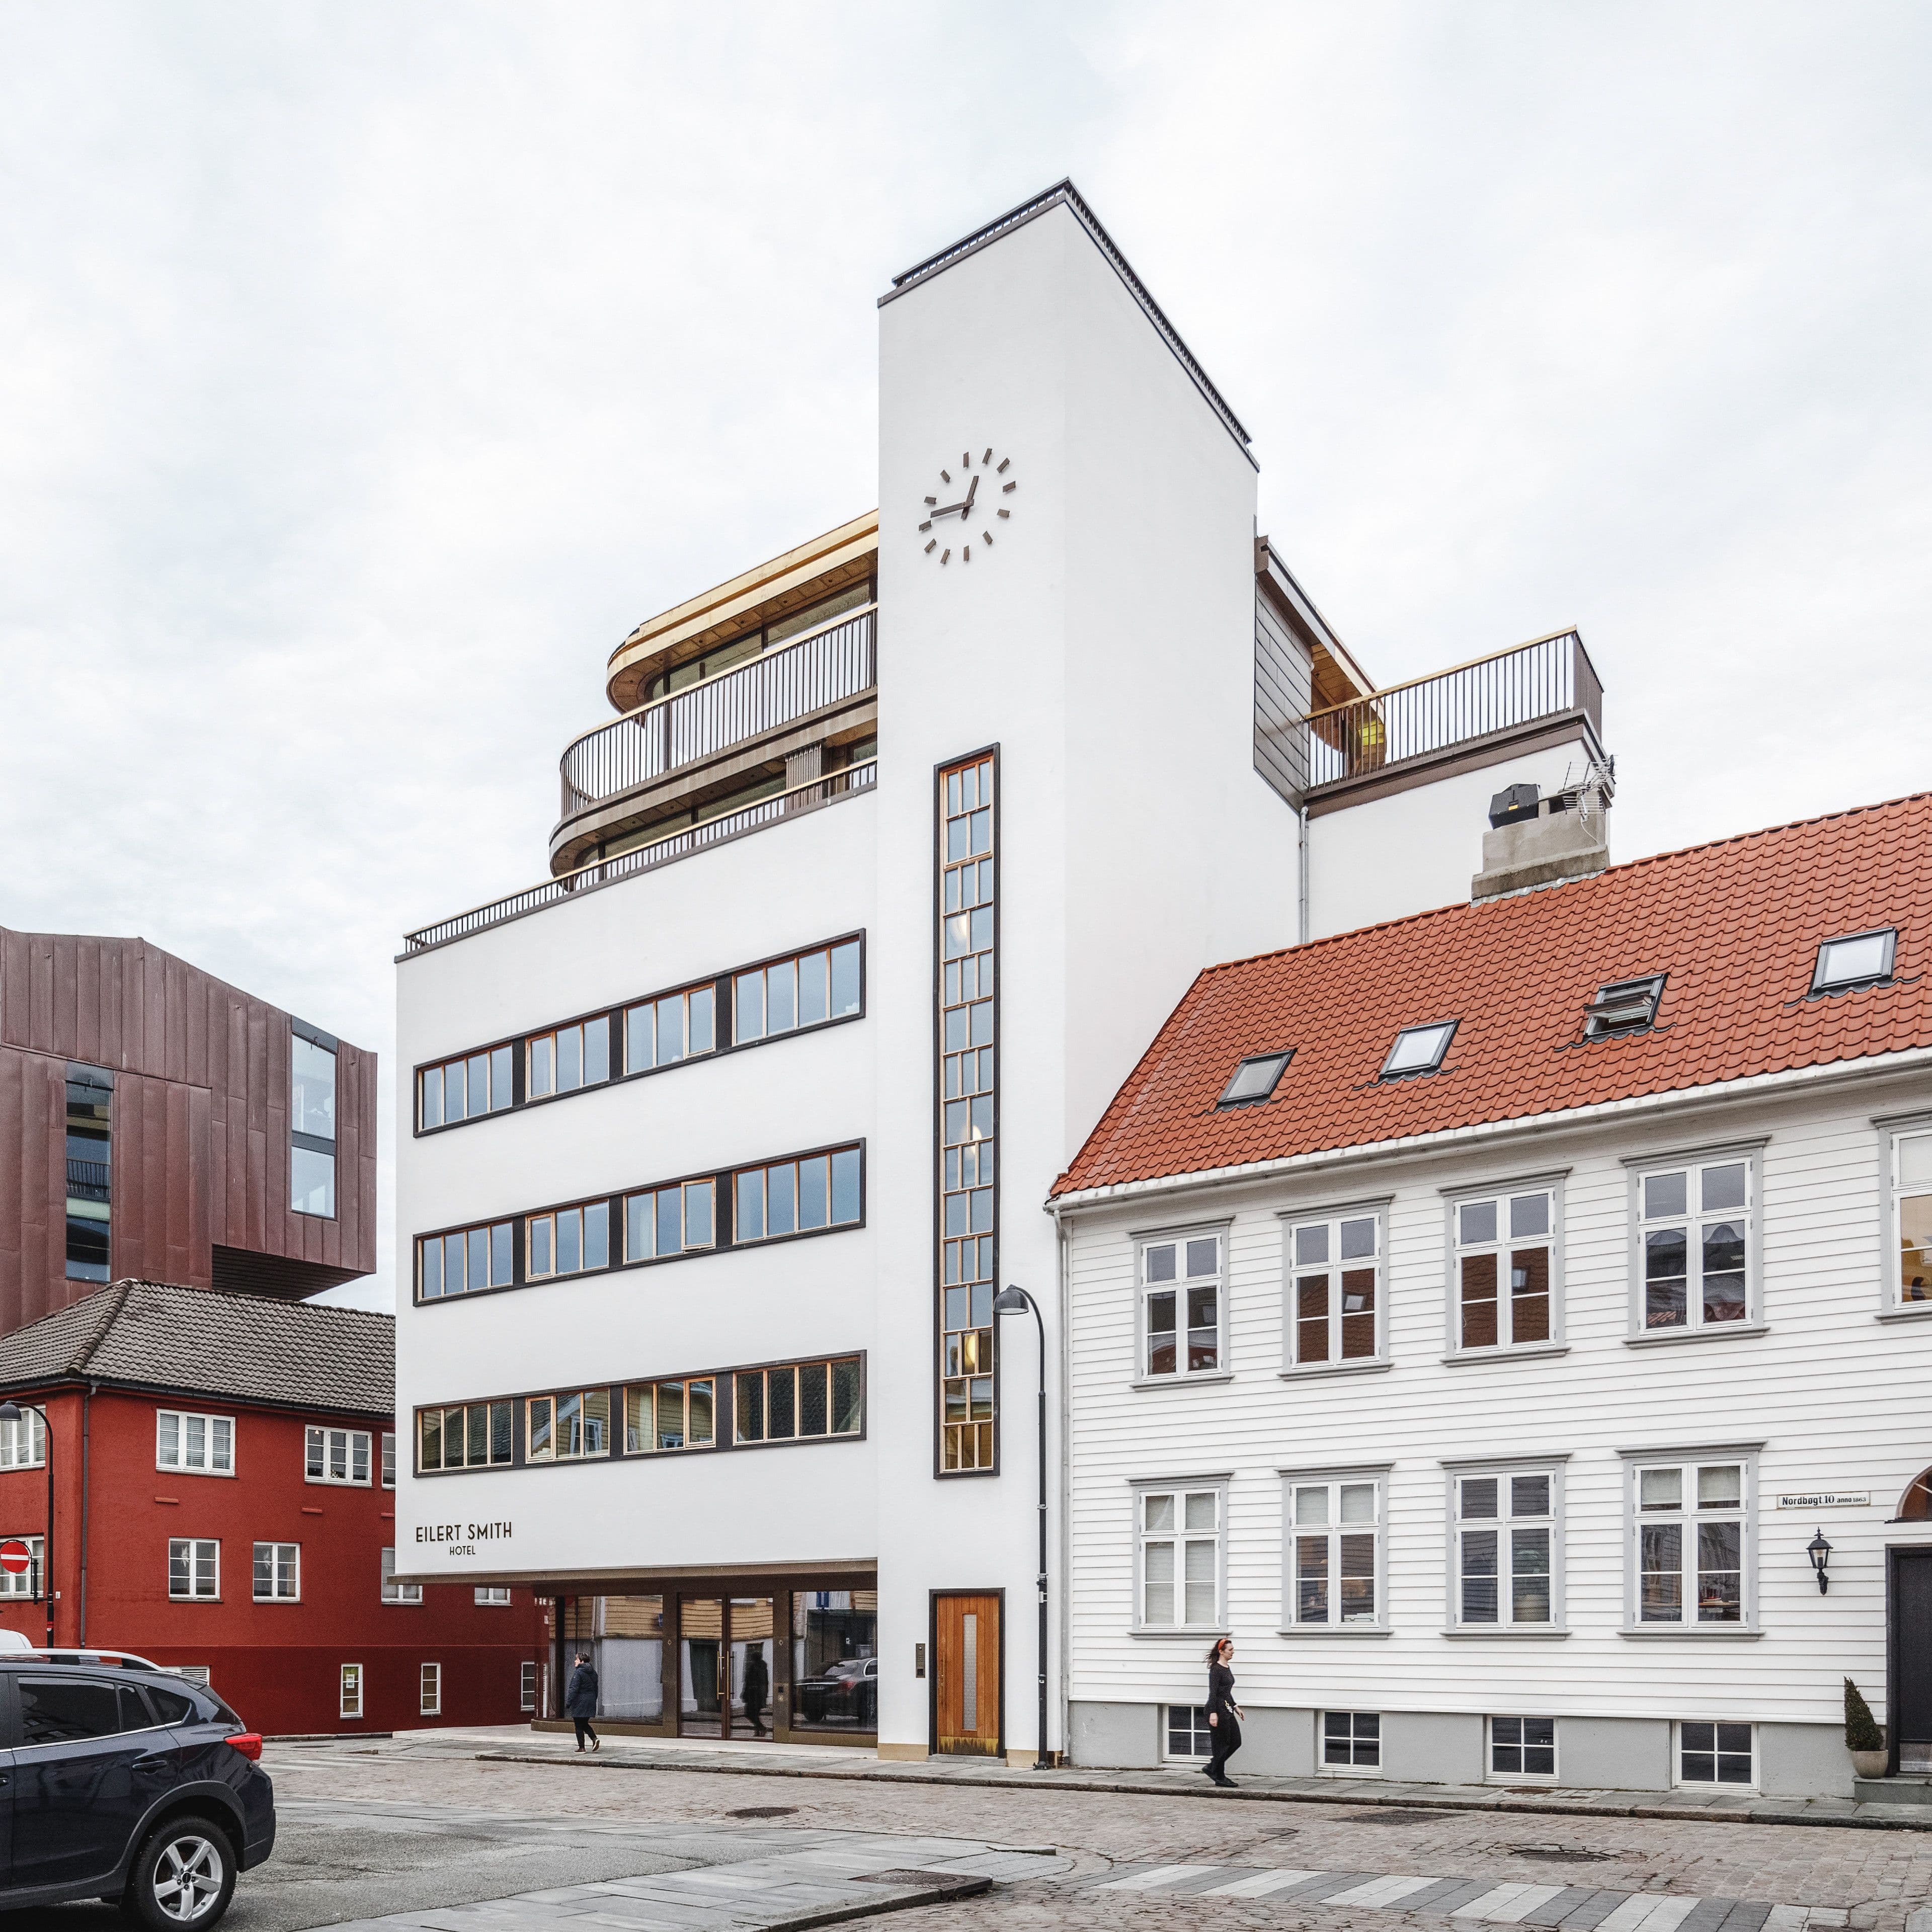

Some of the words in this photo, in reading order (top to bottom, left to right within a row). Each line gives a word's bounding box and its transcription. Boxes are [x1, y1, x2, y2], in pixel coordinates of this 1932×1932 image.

[1825, 1495, 1834, 1503] 10
[416, 1524, 461, 1542] EILERT
[468, 1521, 512, 1540] SMITH
[449, 1546, 475, 1556] HOTEL
